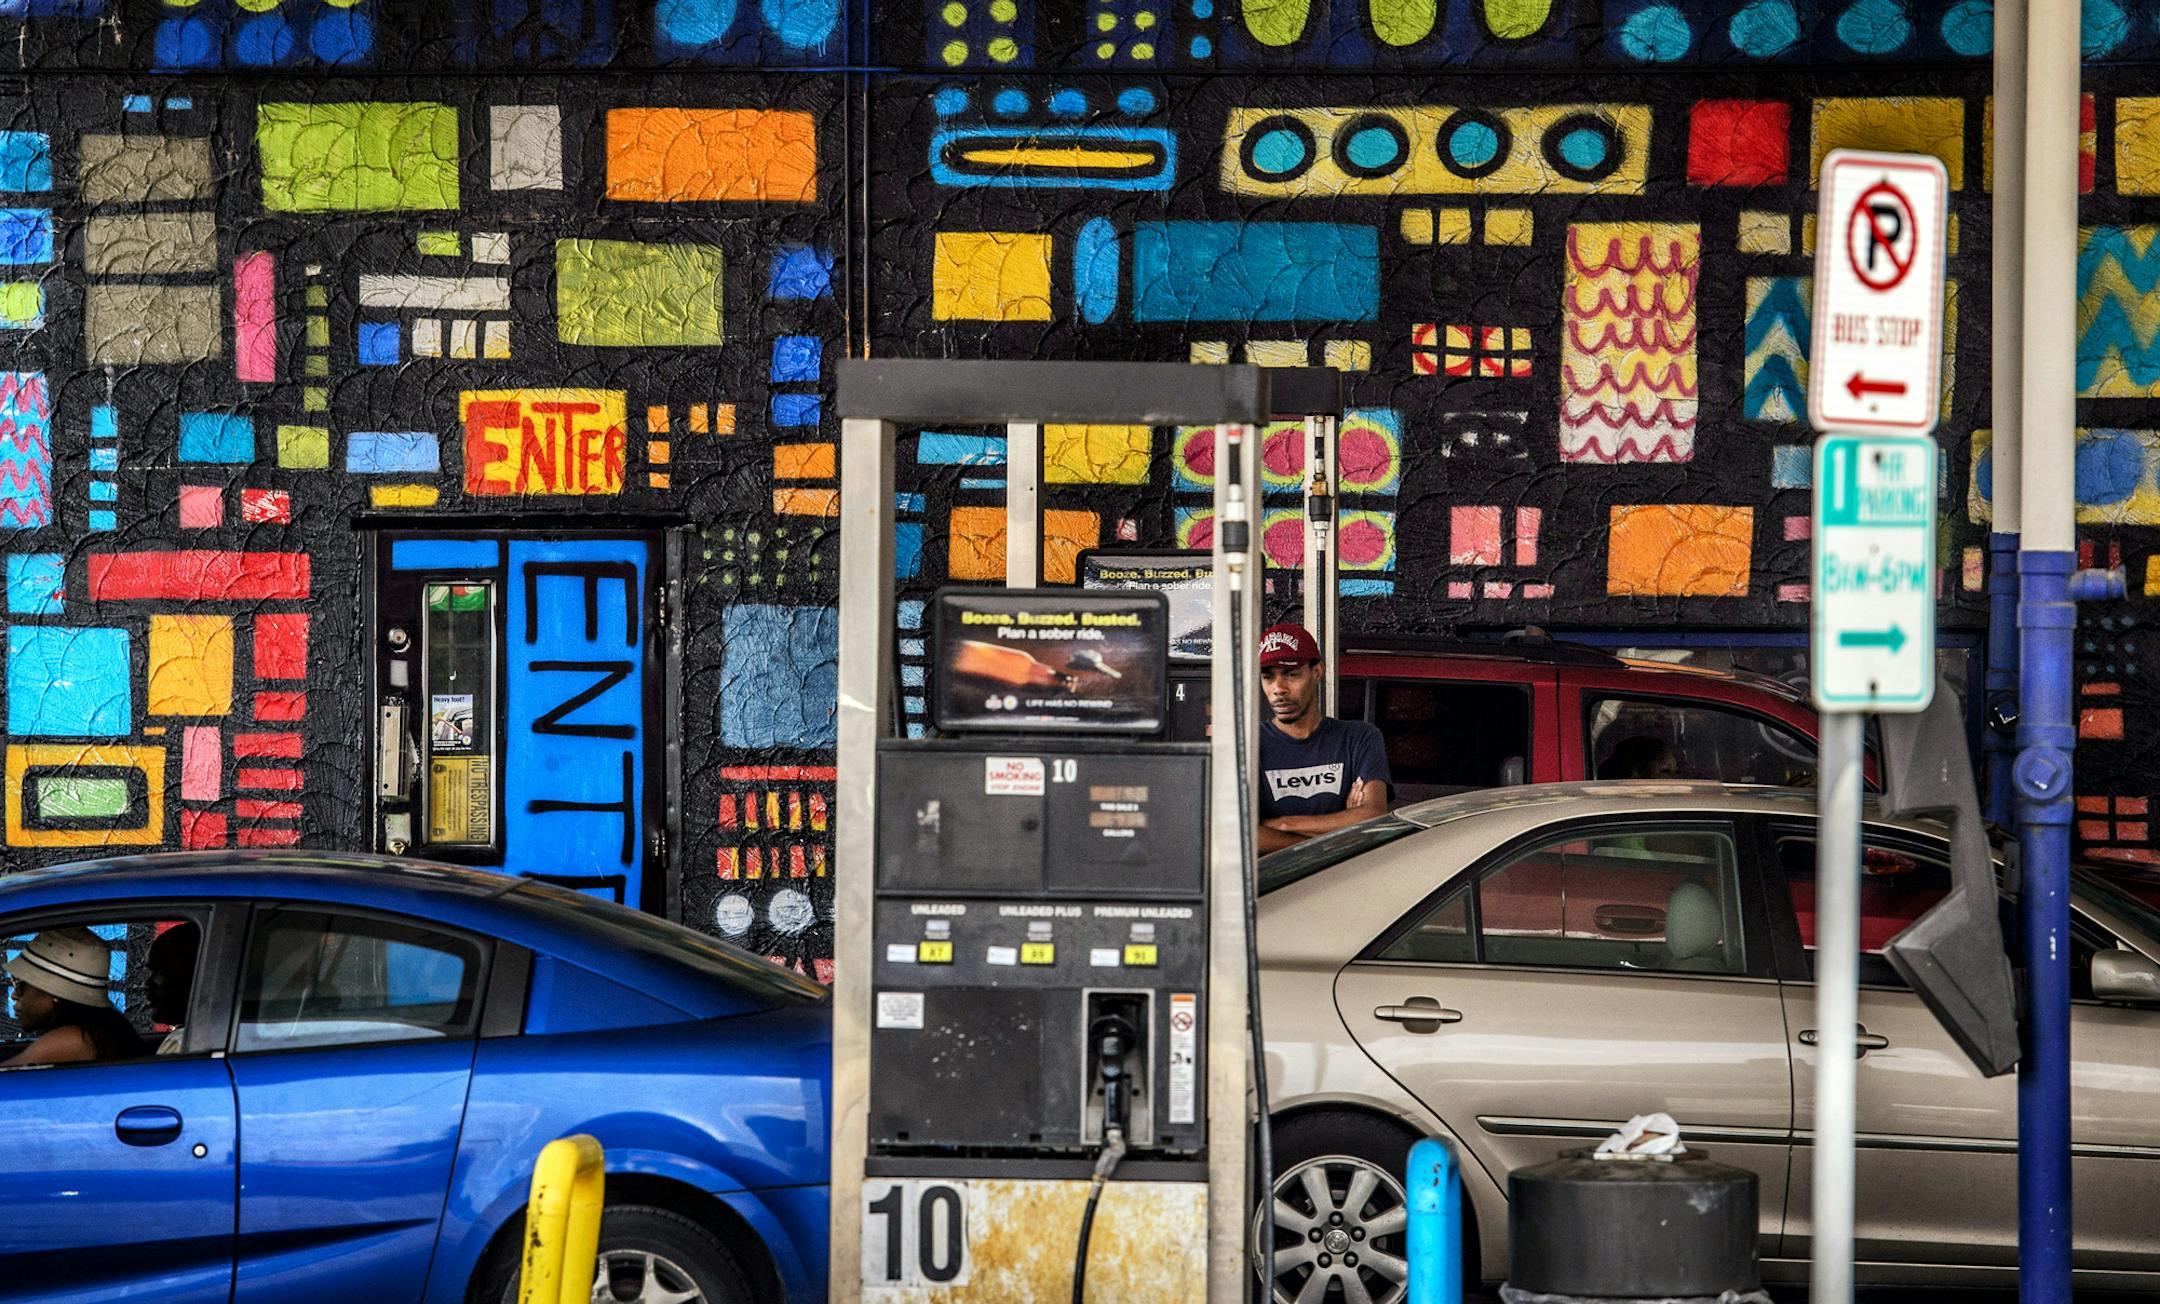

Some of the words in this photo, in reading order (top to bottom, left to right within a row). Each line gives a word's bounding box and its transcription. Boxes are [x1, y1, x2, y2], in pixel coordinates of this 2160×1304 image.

[1834, 313, 1868, 344] BUS
[1876, 315, 1921, 346] STOP
[465, 400, 626, 496] ENTER
[1859, 486, 1927, 518] PARKING
[1100, 569, 1141, 579] Booze.
[1144, 569, 1191, 579] Buzzed.
[1128, 581, 1150, 590] Plan
[1161, 581, 1190, 590] sober
[961, 611, 1014, 625] Booze.
[1017, 611, 1078, 625] Buzzed.
[1081, 612, 1142, 626] Busted.
[997, 626, 1026, 639] Plan
[1027, 629, 1037, 639] a
[1039, 627, 1075, 640] sober
[1076, 628, 1105, 640] ride.
[1175, 683, 1185, 701] 4
[433, 696, 450, 704] Heavy
[1006, 762, 1024, 771] NO
[1052, 759, 1078, 783] 10
[989, 772, 1042, 782] SMOKING
[911, 904, 967, 916] UNLEADED
[999, 905, 1054, 917] UNLEADED
[1055, 906, 1083, 917] PLUS
[1093, 906, 1140, 918] PREMIUM
[1141, 907, 1193, 918] UNLEADED
[869, 1185, 963, 1281] 10
